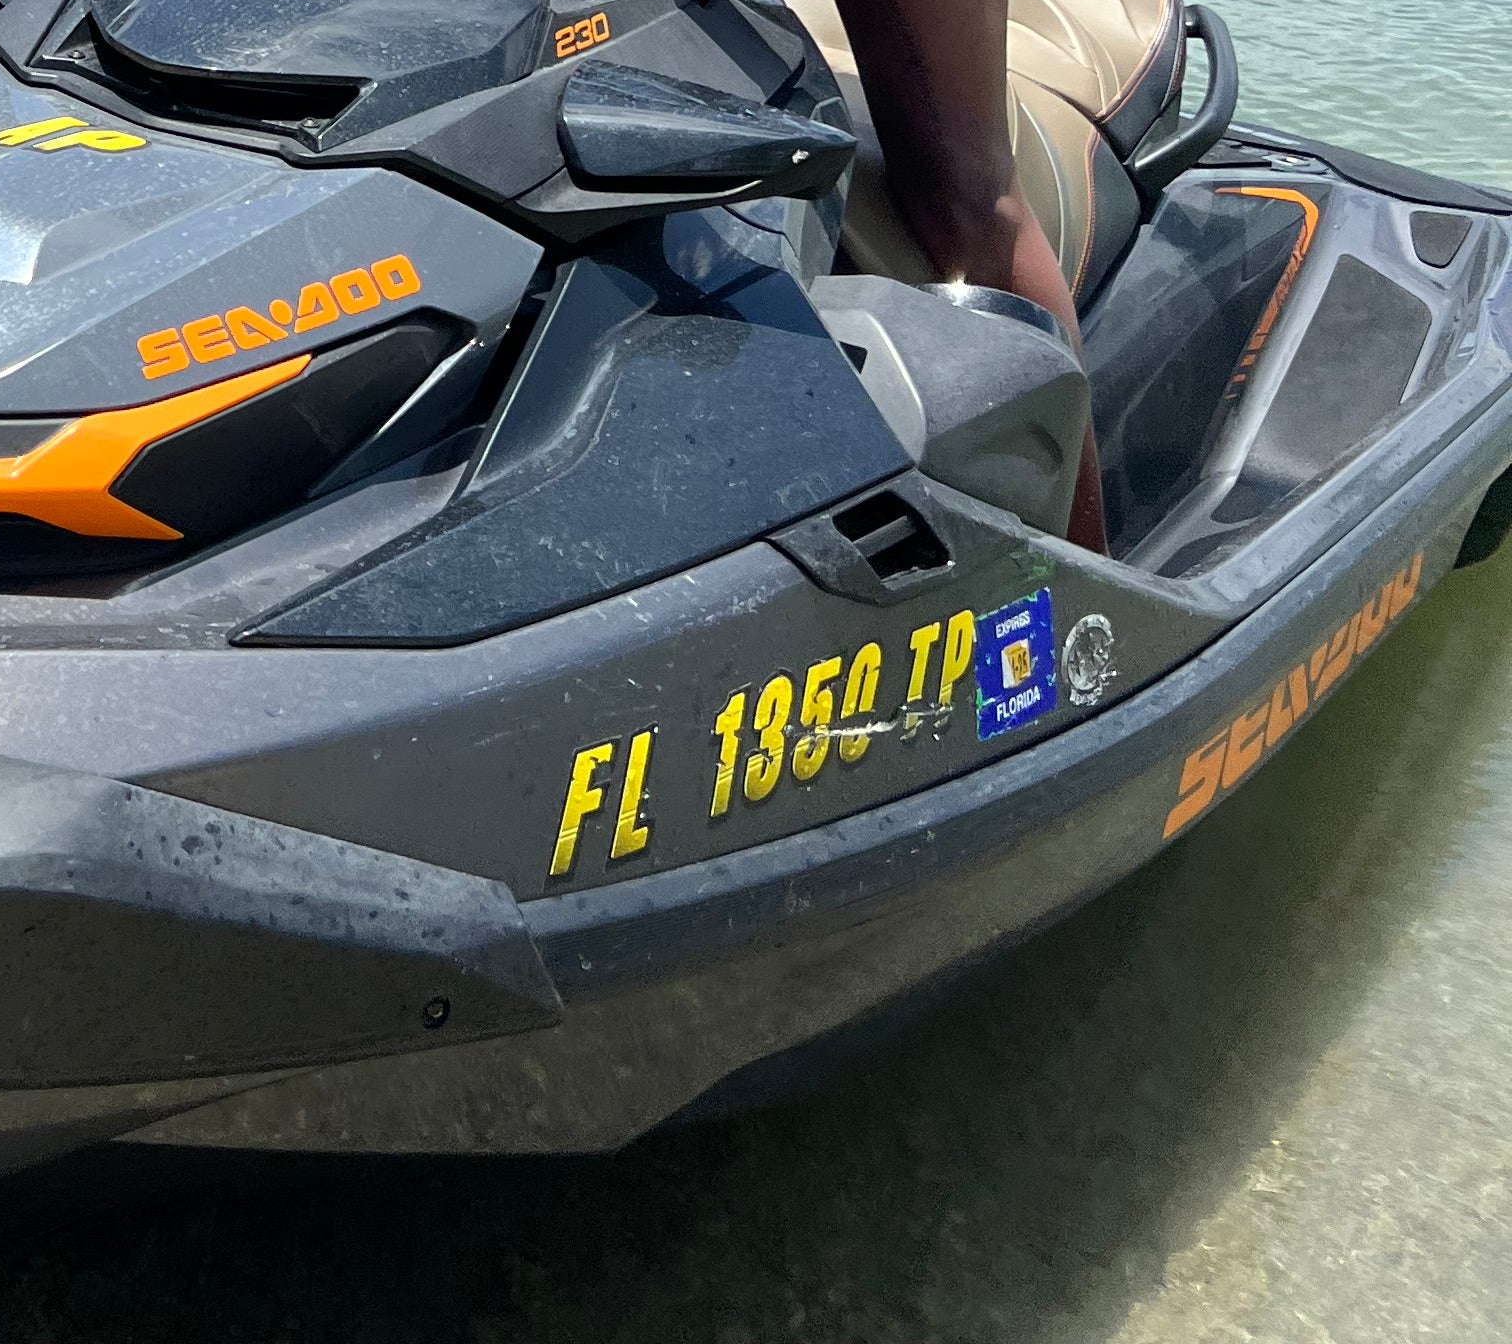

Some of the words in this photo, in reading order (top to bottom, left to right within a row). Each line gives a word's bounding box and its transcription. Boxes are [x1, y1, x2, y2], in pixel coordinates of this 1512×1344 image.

[554, 12, 610, 59] 230
[995, 610, 1031, 639] EXPIRES
[996, 685, 1041, 723] FLORIDA
[549, 730, 652, 877] FL
[710, 641, 883, 818] 1350
[902, 608, 975, 742] TP
